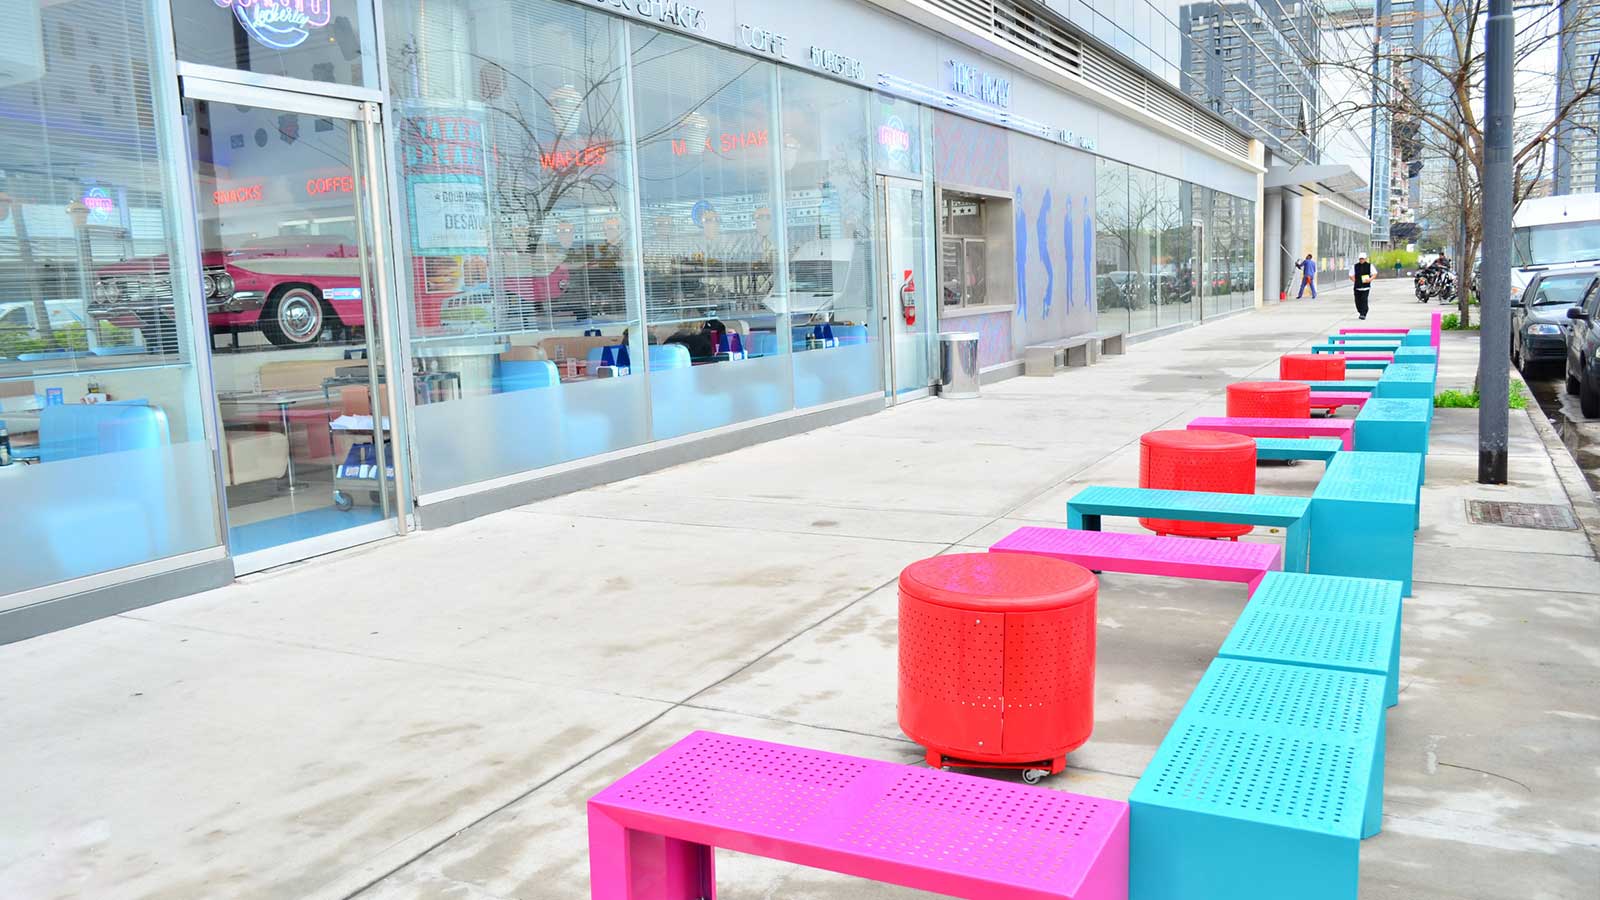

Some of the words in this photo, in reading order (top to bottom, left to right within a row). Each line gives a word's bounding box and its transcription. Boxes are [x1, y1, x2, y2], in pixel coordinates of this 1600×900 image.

[637, 0, 708, 31] SHAKES
[810, 45, 865, 81] BURGERS
[671, 136, 715, 157] MK
[212, 184, 264, 207] SNACKS
